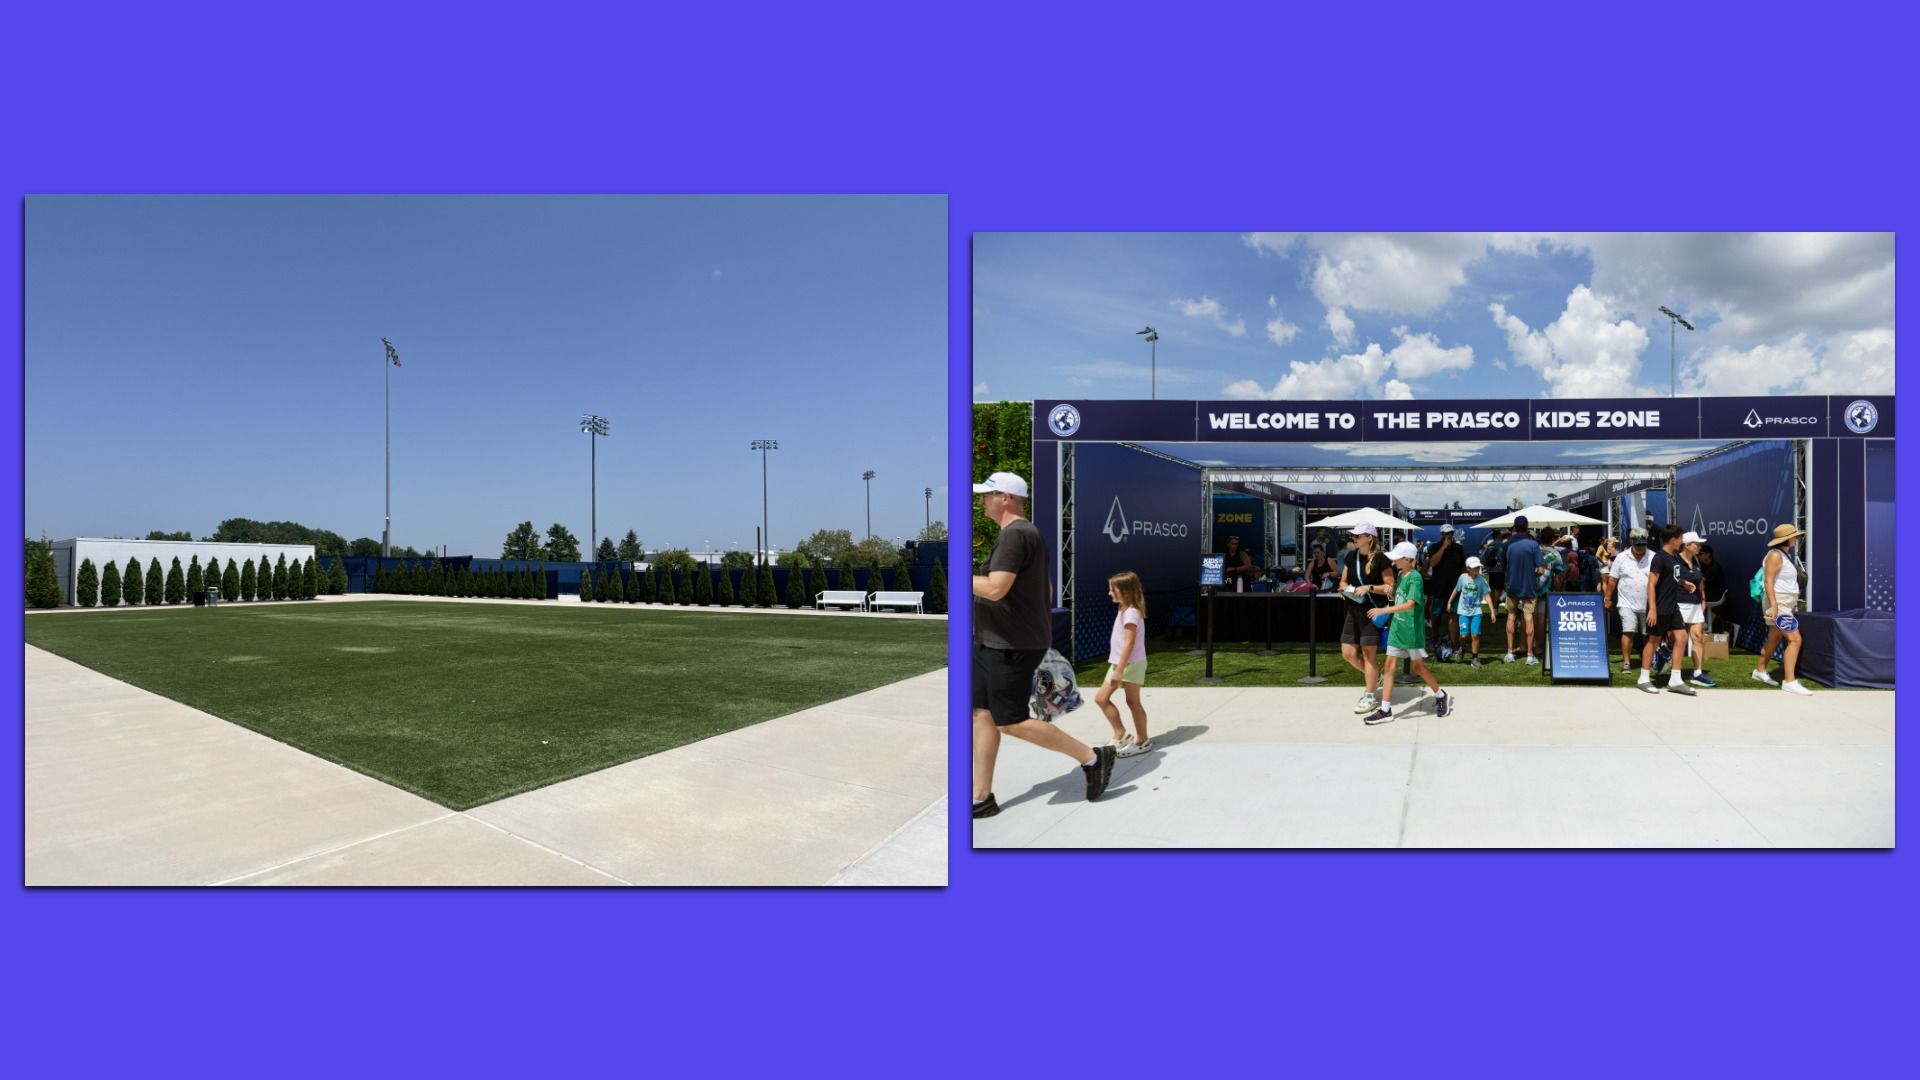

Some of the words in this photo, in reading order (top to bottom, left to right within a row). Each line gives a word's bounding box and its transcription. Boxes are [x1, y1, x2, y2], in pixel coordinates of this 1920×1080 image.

[1208, 412, 1321, 430] WELCOME
[1324, 412, 1356, 430] TO
[1373, 411, 1421, 429] THE
[1426, 411, 1521, 429] PRASCO
[1535, 410, 1591, 429] KIDS
[1596, 410, 1660, 428] ZONE
[1765, 416, 1818, 425] PRASCO
[1217, 513, 1253, 523] ZONE
[1133, 520, 1188, 538] PRASCO
[1708, 517, 1768, 535] PRASCO
[1560, 611, 1594, 622] KIDS
[1557, 621, 1597, 632] ZONE
